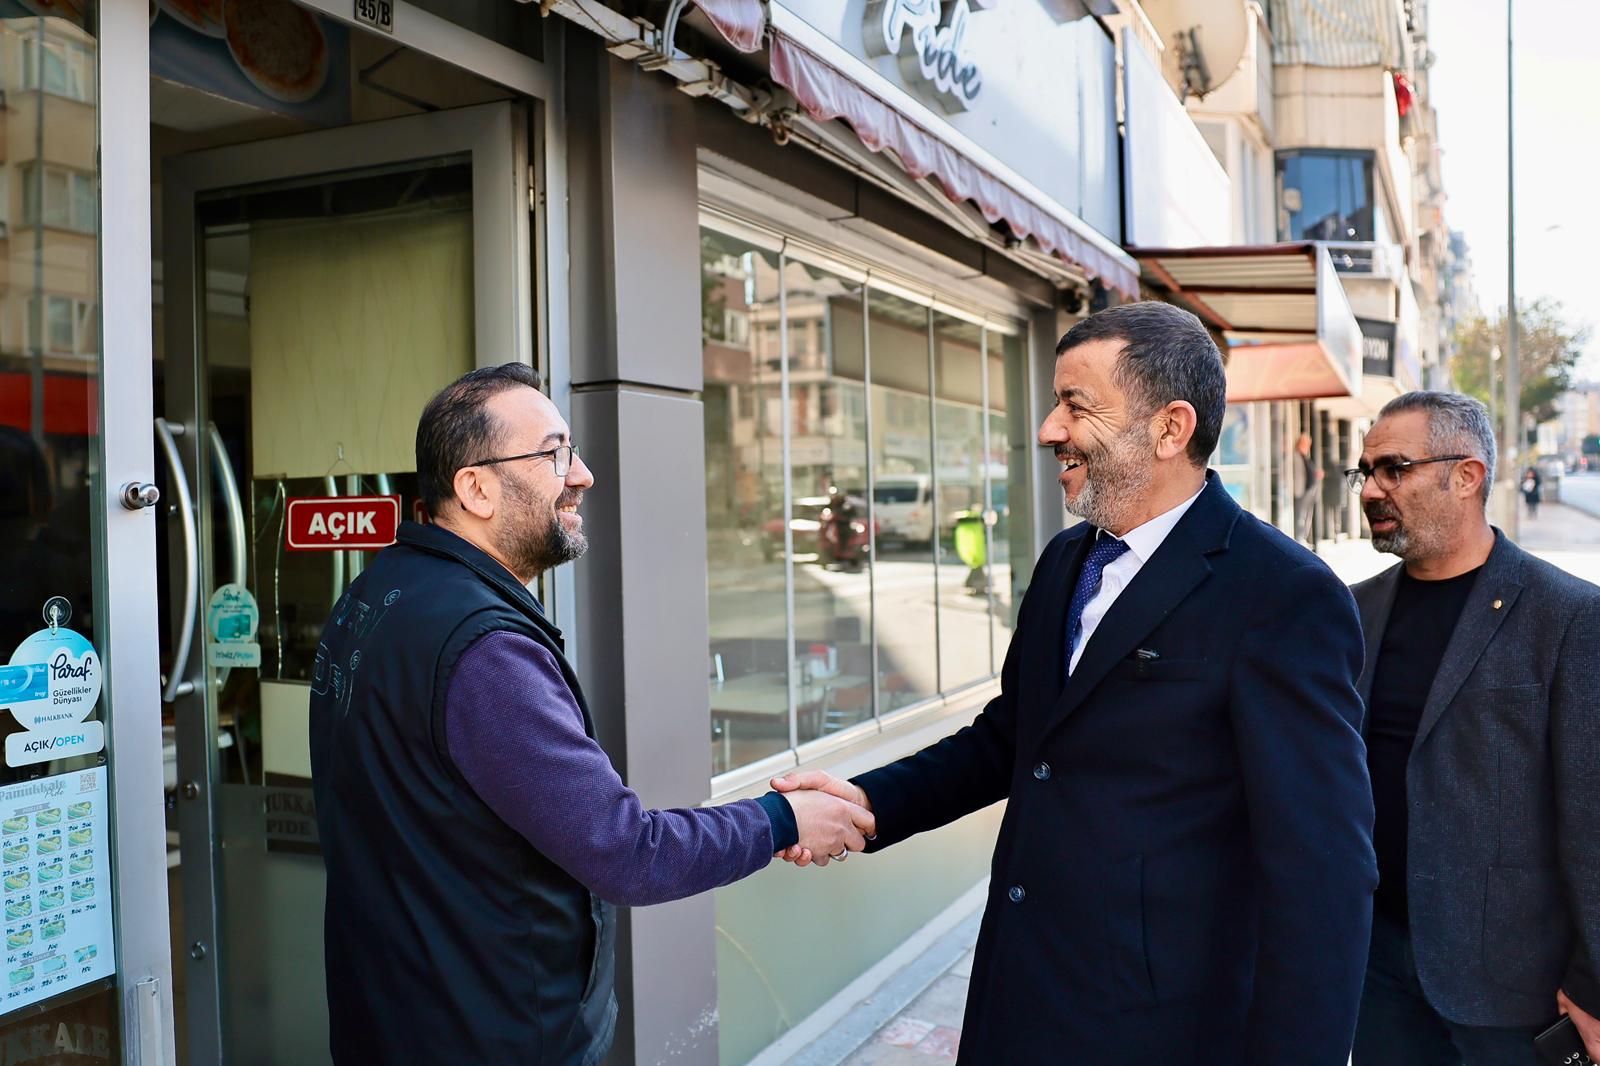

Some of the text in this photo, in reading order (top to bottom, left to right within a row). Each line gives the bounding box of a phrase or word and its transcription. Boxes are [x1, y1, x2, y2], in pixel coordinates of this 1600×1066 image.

[359, 0, 391, 26] 45/B
[308, 511, 377, 540] AÇIK
[52, 687, 92, 698] Güzellikler
[53, 697, 82, 705] Dünyası
[41, 713, 74, 722] HALKBANK
[24, 734, 85, 753] AÇIK/OPEN
[0, 1022, 110, 1066] KKALE
